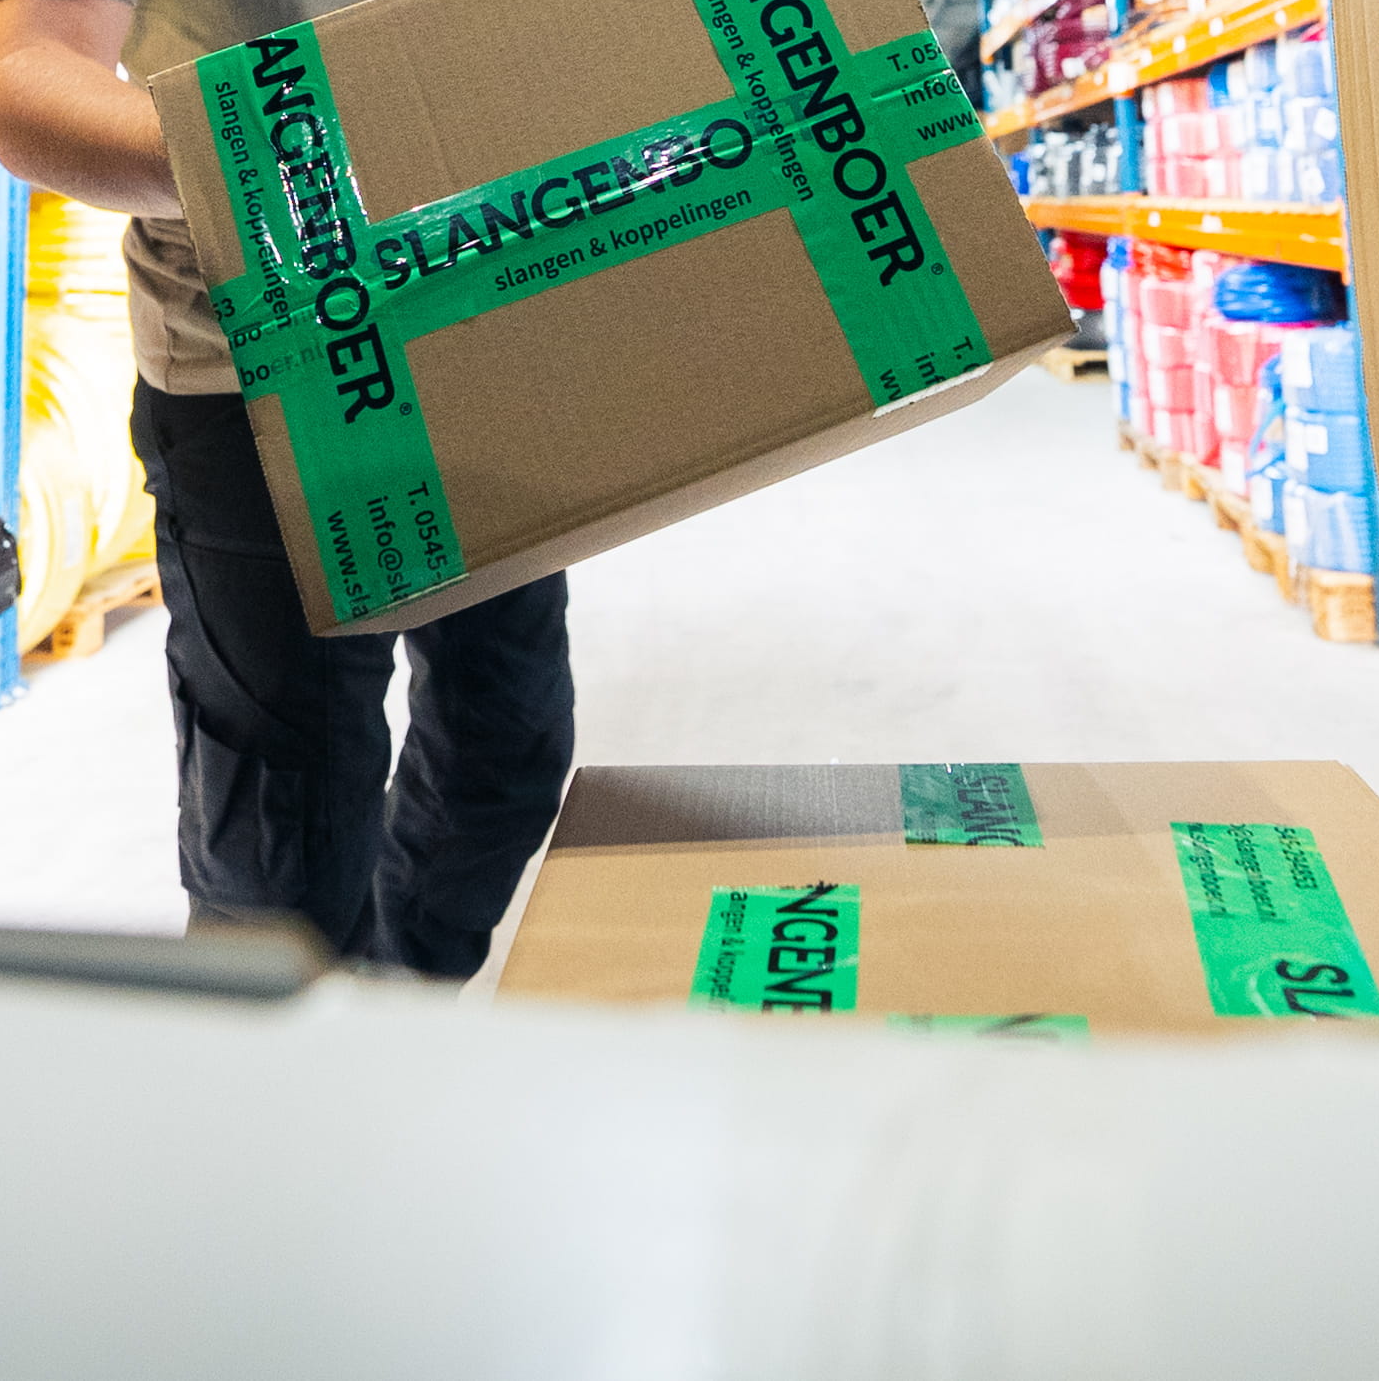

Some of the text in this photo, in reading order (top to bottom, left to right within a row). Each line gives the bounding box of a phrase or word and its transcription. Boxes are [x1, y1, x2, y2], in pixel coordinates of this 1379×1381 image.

[737, 51, 756, 69] &
[887, 43, 942, 72] T. 05
[745, 70, 814, 202] koppelingen
[216, 81, 292, 330] slangen & koppelingen
[495, 186, 753, 291] slangen & koppelingen
[408, 481, 430, 507] T.
